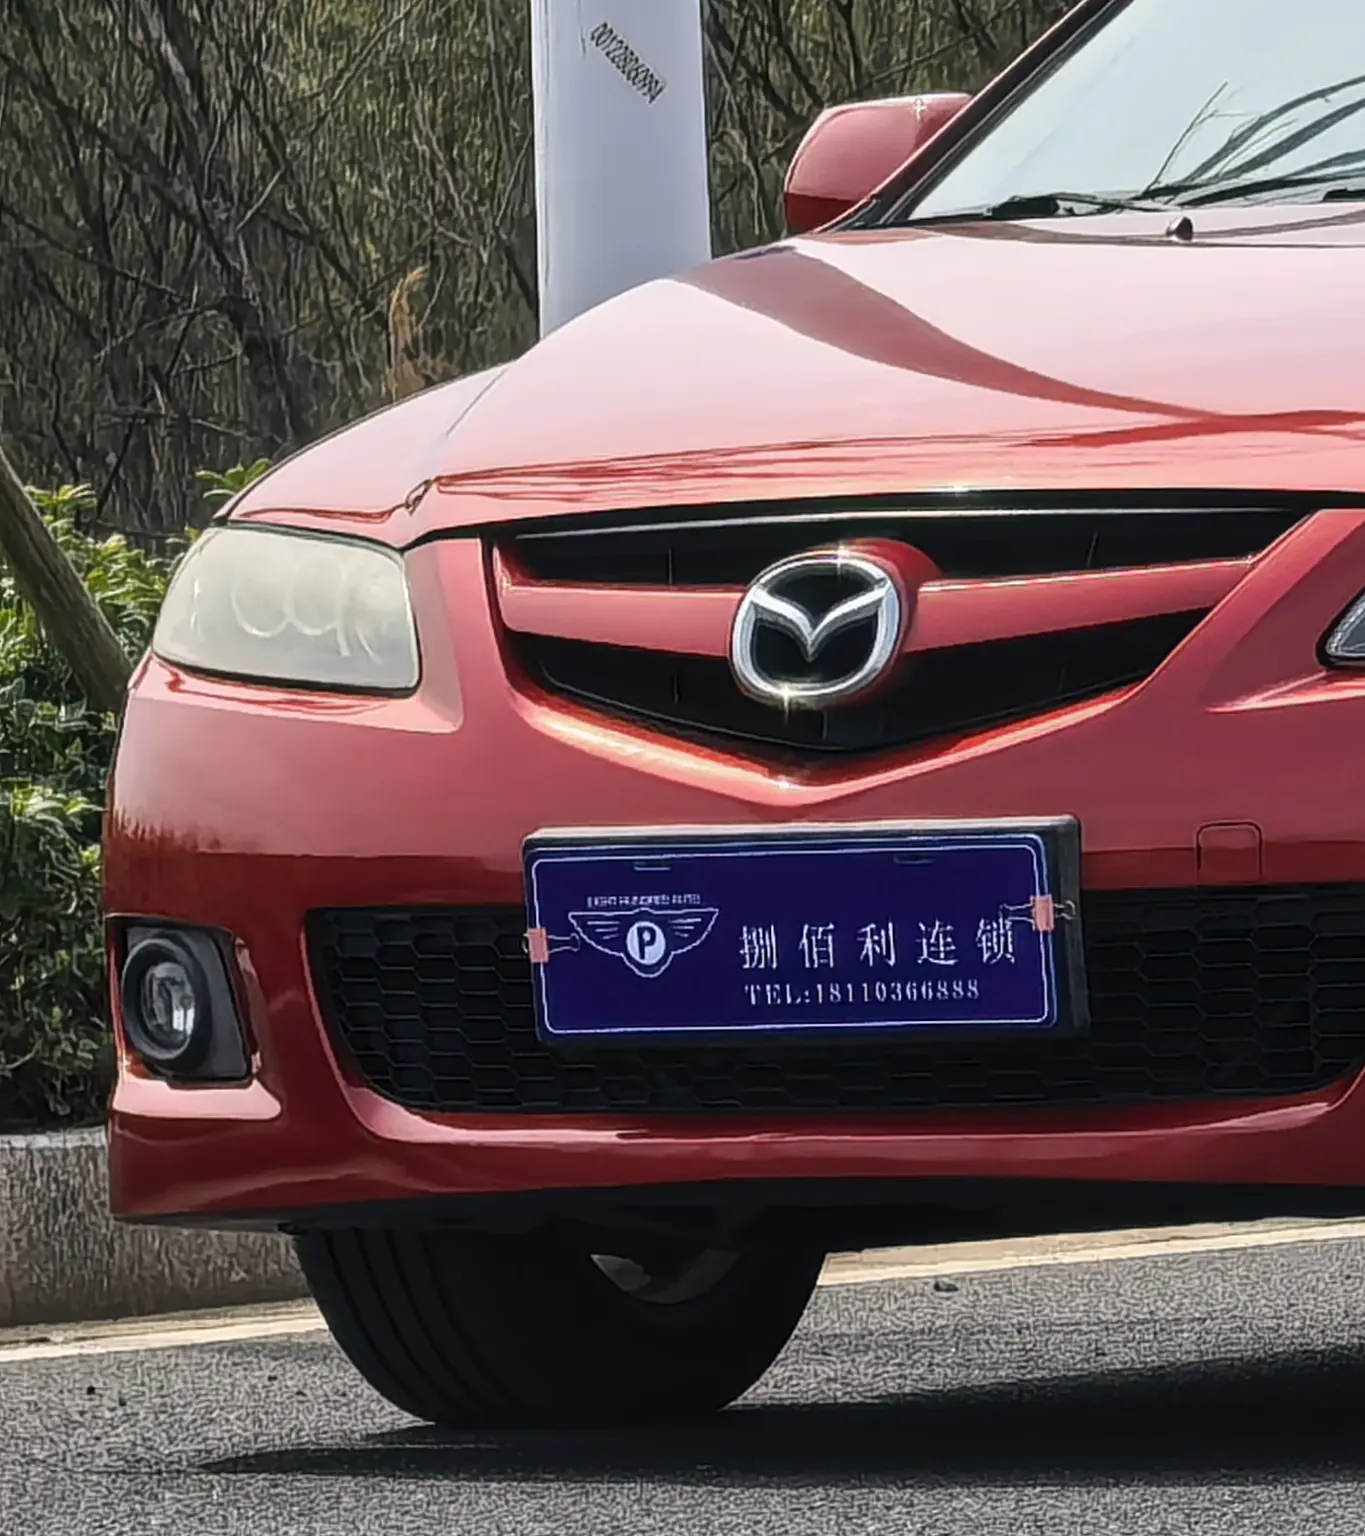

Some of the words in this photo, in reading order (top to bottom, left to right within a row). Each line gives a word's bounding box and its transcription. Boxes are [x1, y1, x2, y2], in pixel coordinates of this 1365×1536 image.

[636, 925, 657, 961] P
[738, 917, 1017, 969] 捌佰利连锁
